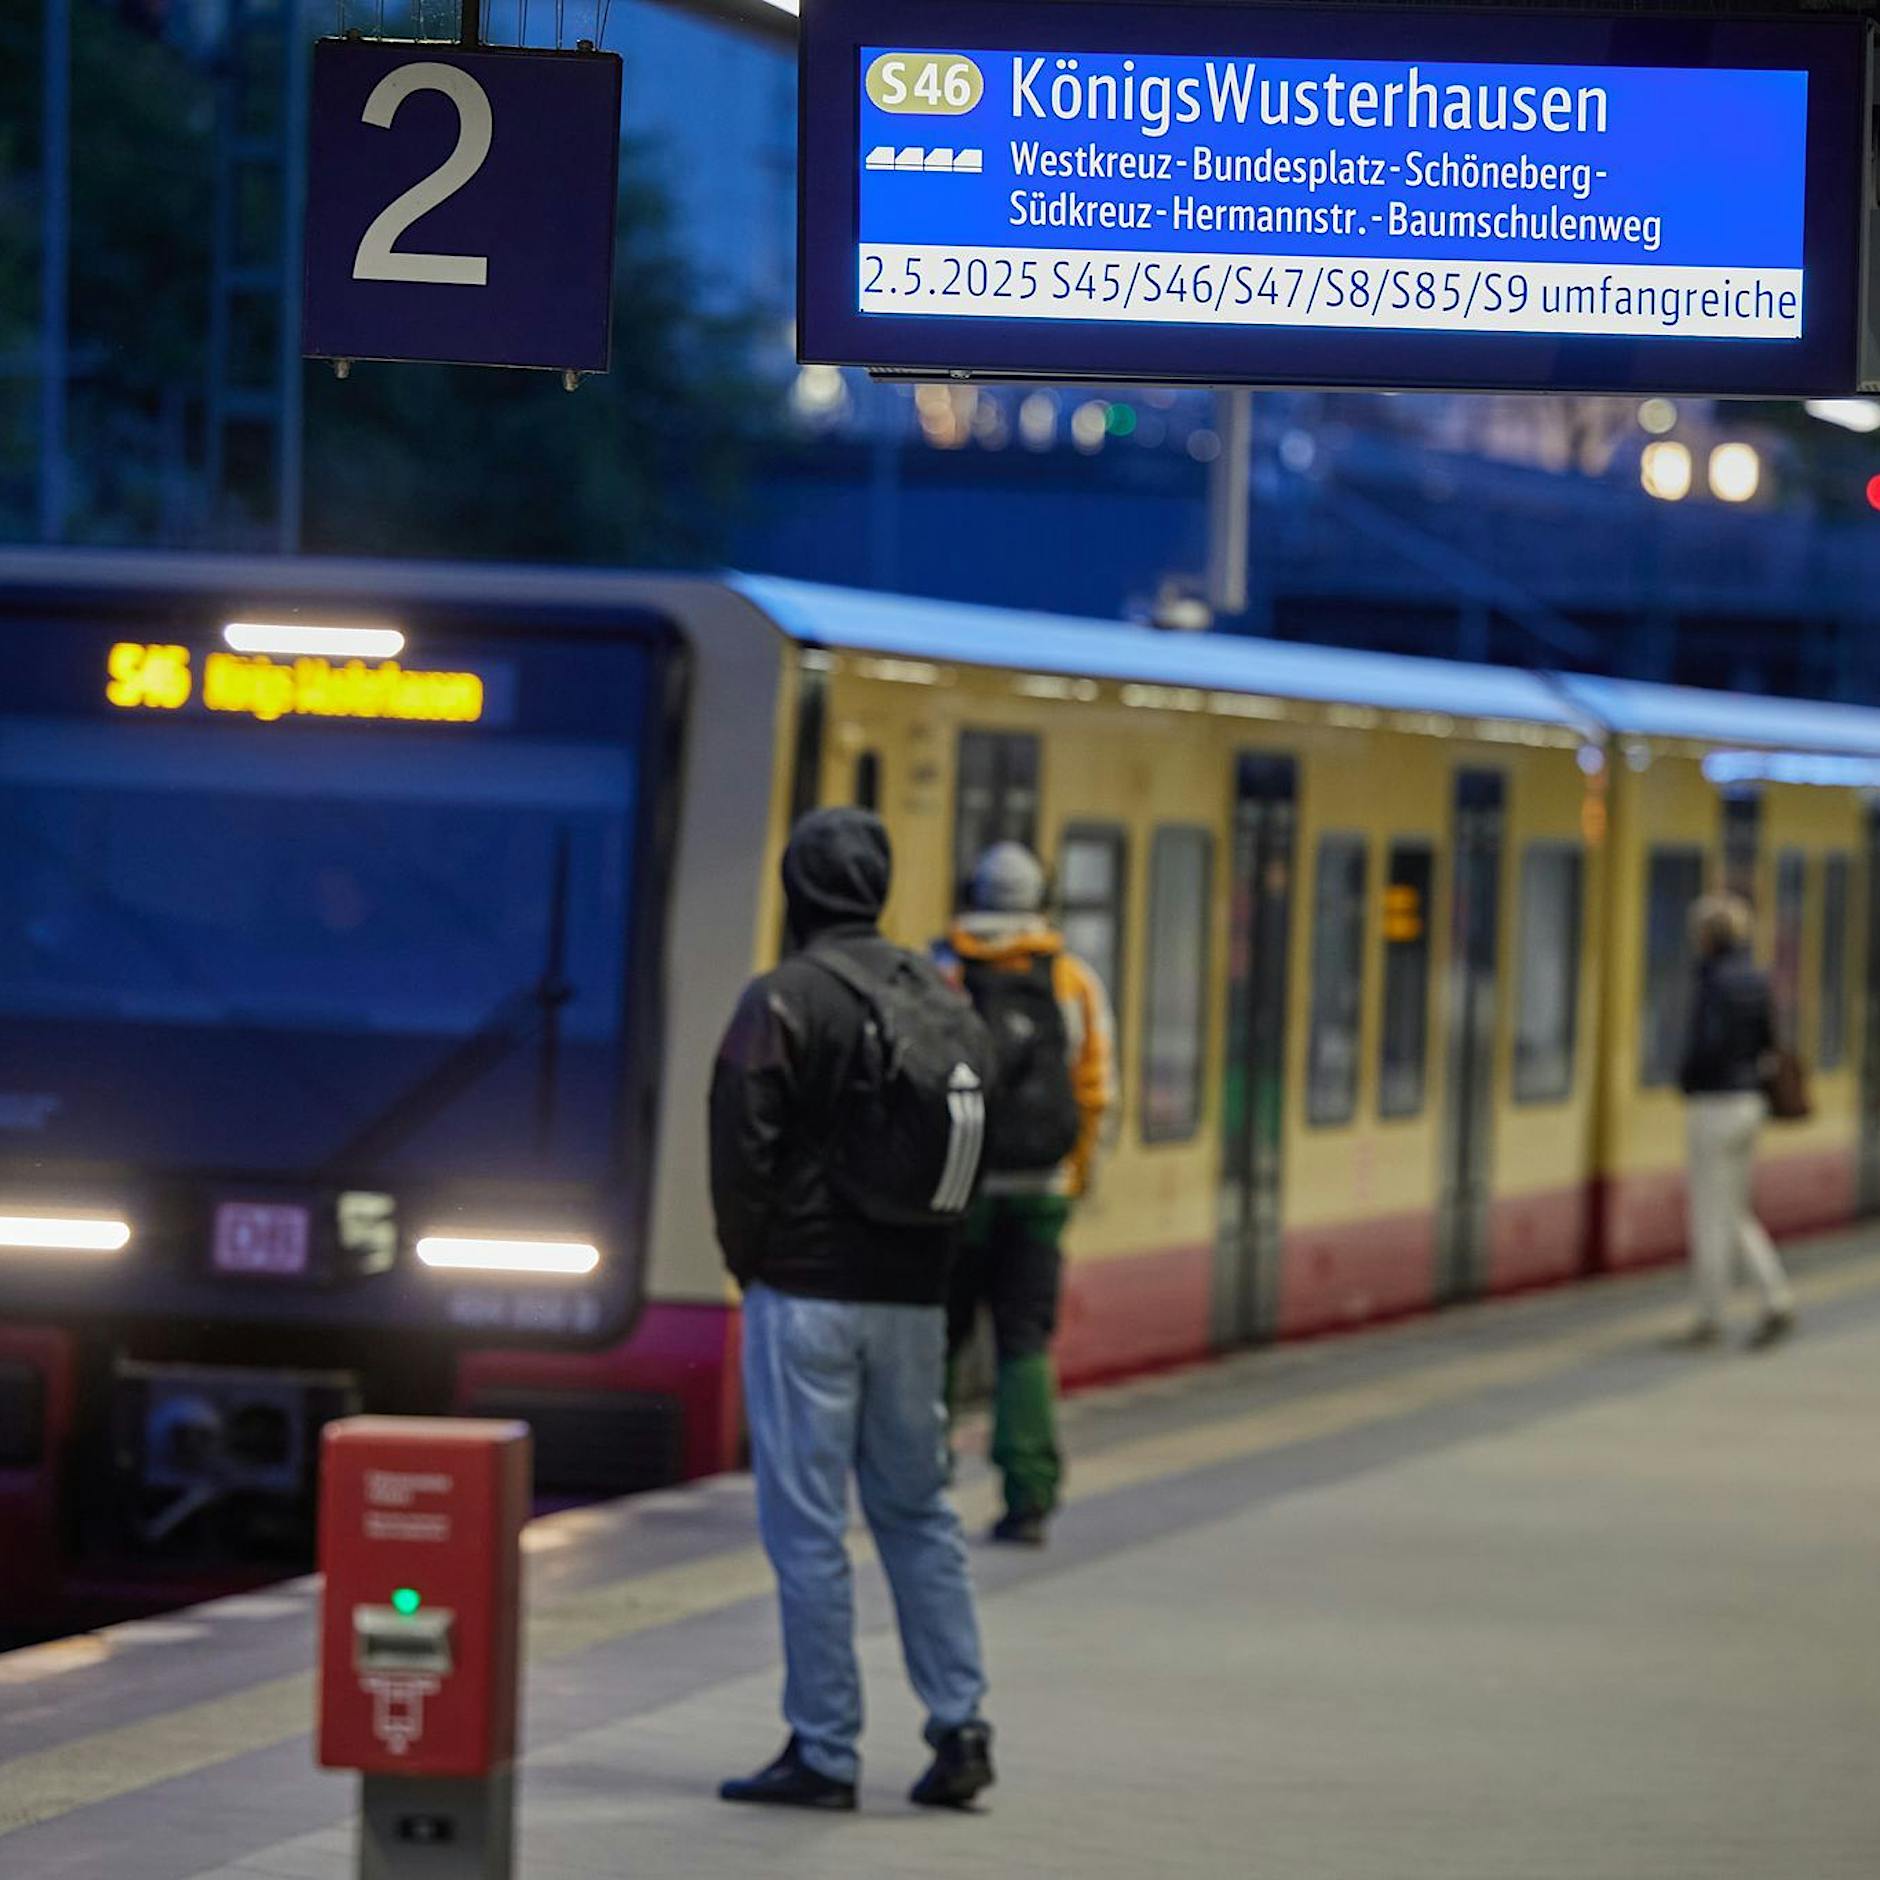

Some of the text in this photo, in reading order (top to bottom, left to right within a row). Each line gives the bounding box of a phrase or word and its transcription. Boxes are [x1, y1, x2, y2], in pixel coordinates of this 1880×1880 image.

[353, 62, 493, 286] 2
[863, 255, 1798, 326] 2.5.2025 S45/S46/S47/S8/S85/S9 umfangreiche
